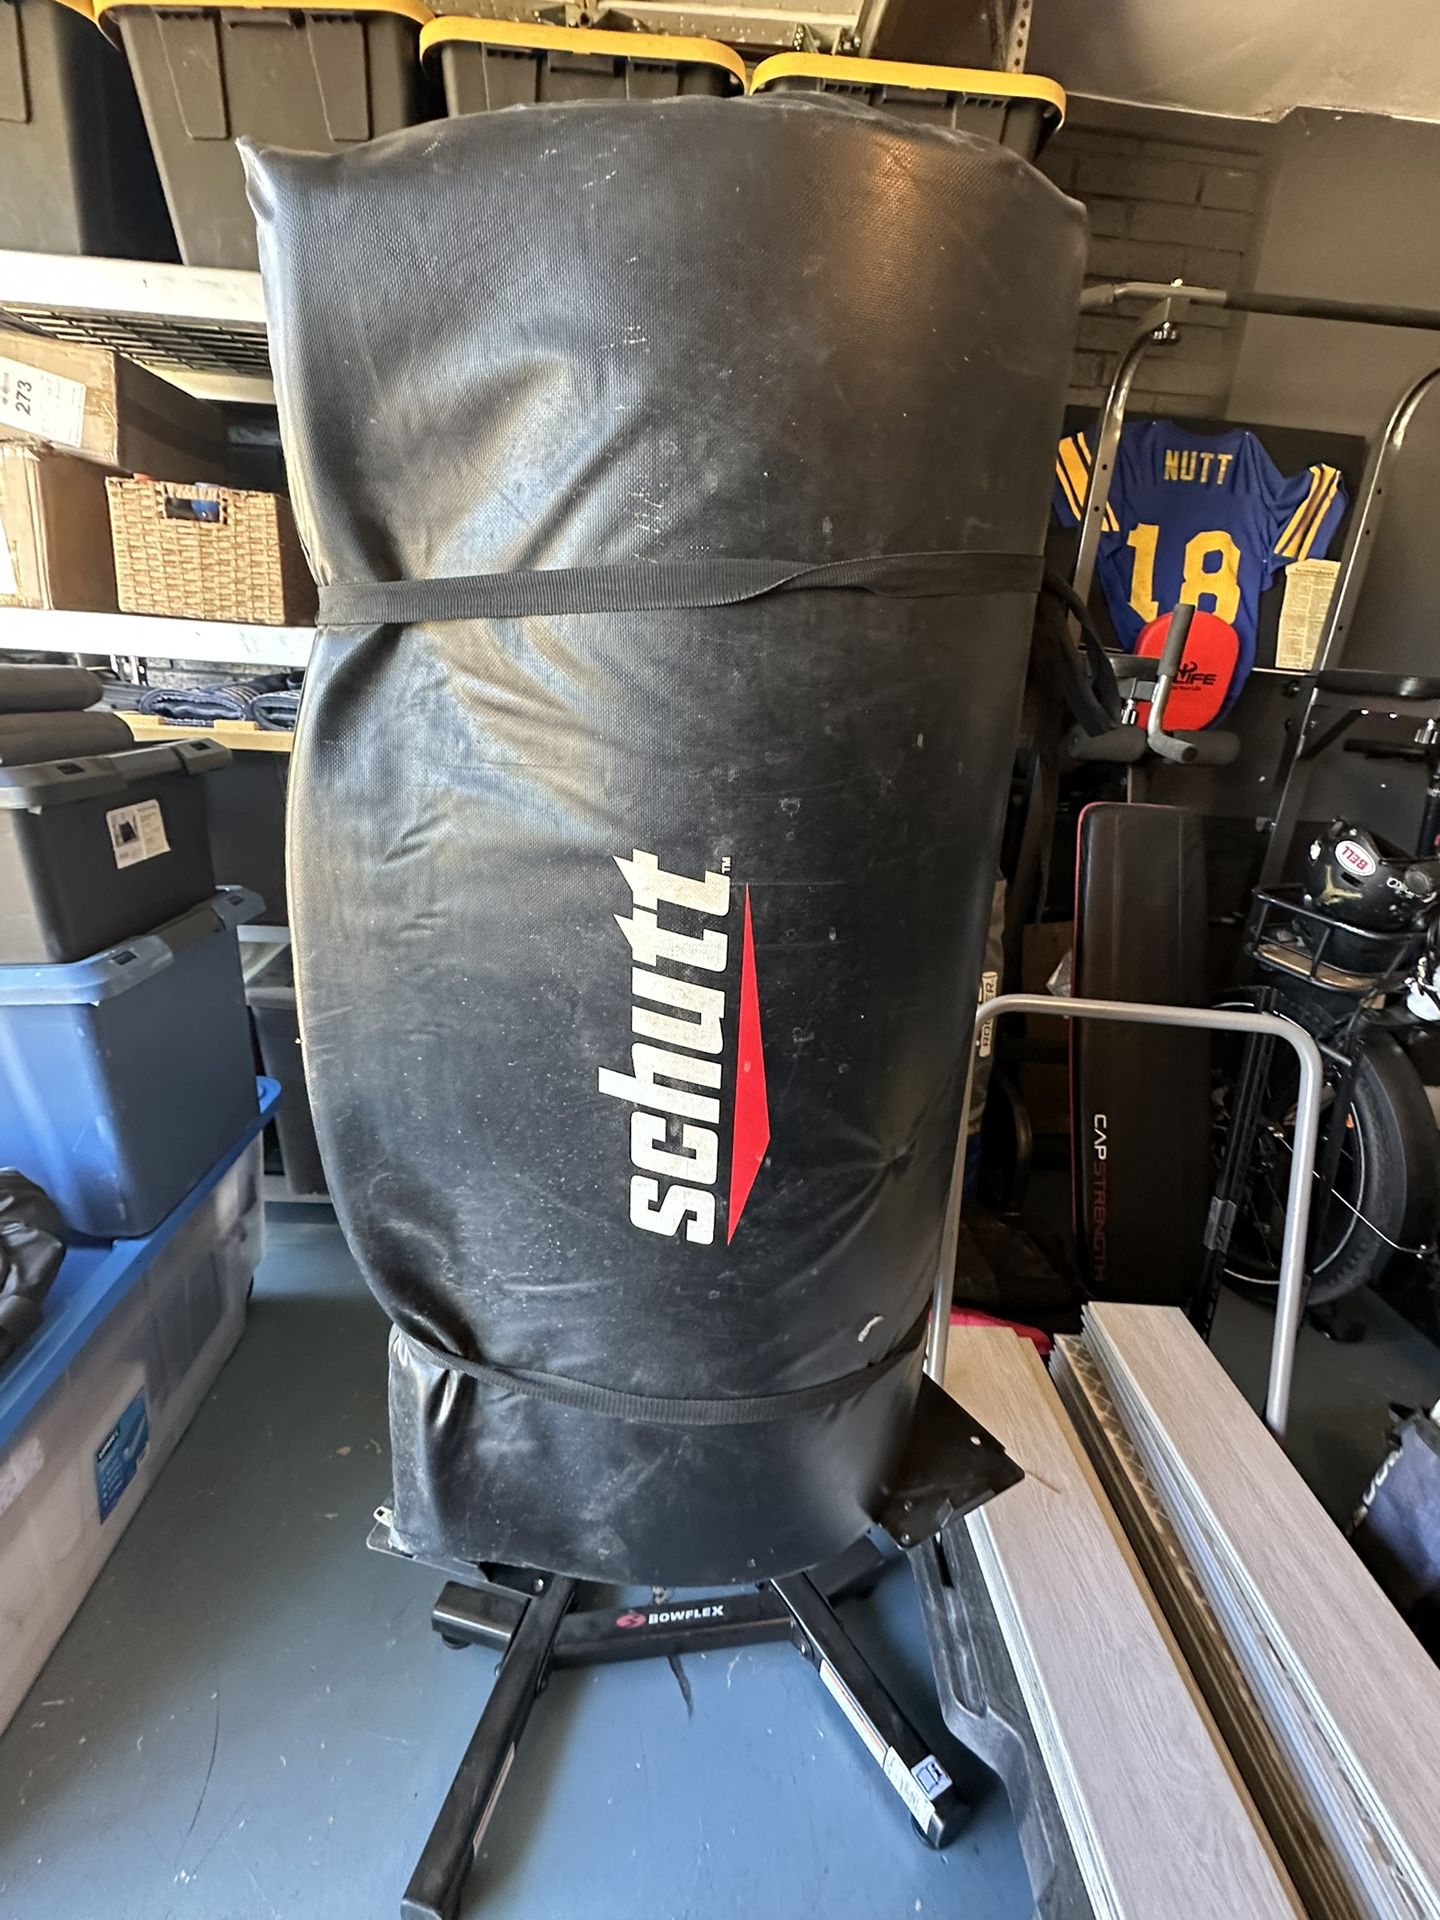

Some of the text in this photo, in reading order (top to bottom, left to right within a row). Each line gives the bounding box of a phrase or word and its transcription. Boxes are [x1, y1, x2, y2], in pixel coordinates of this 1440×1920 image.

[15, 379, 32, 416] 273
[1164, 449, 1233, 485] NUTT
[1126, 522, 1241, 625] 18
[1172, 672, 1217, 686] LIFE
[1341, 845, 1369, 871] BELL
[598, 848, 731, 1246] schutt
[648, 1605, 724, 1625] BOWFLEX
